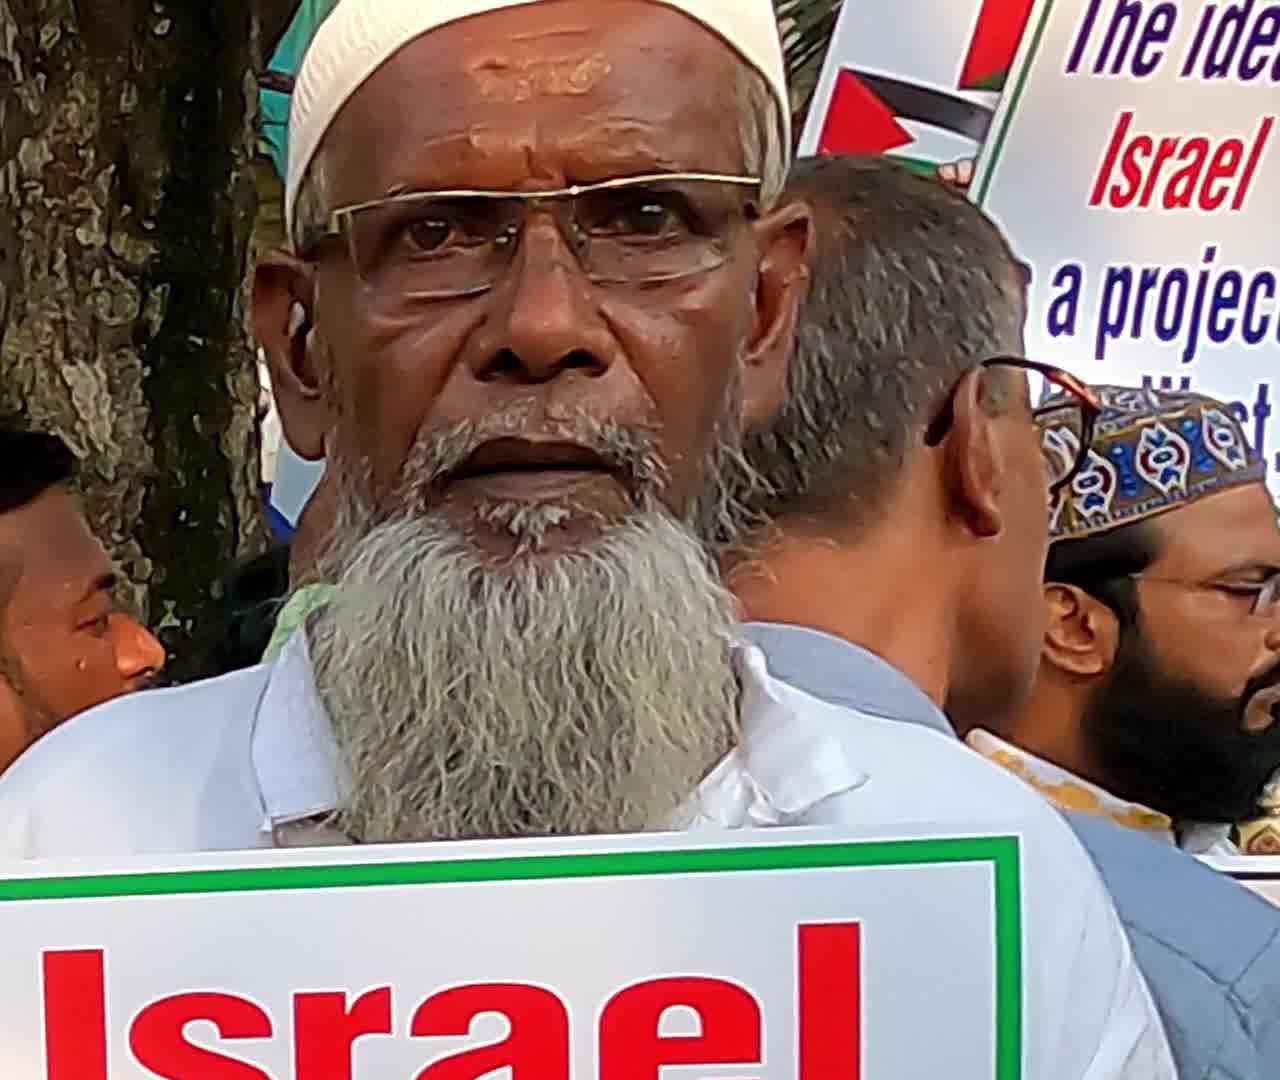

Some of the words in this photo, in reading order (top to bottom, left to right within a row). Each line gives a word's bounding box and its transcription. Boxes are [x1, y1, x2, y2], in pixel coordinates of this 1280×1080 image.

[1090, 112, 1273, 211] Israel
[1048, 263, 1082, 337] a
[1095, 247, 1280, 363] projec
